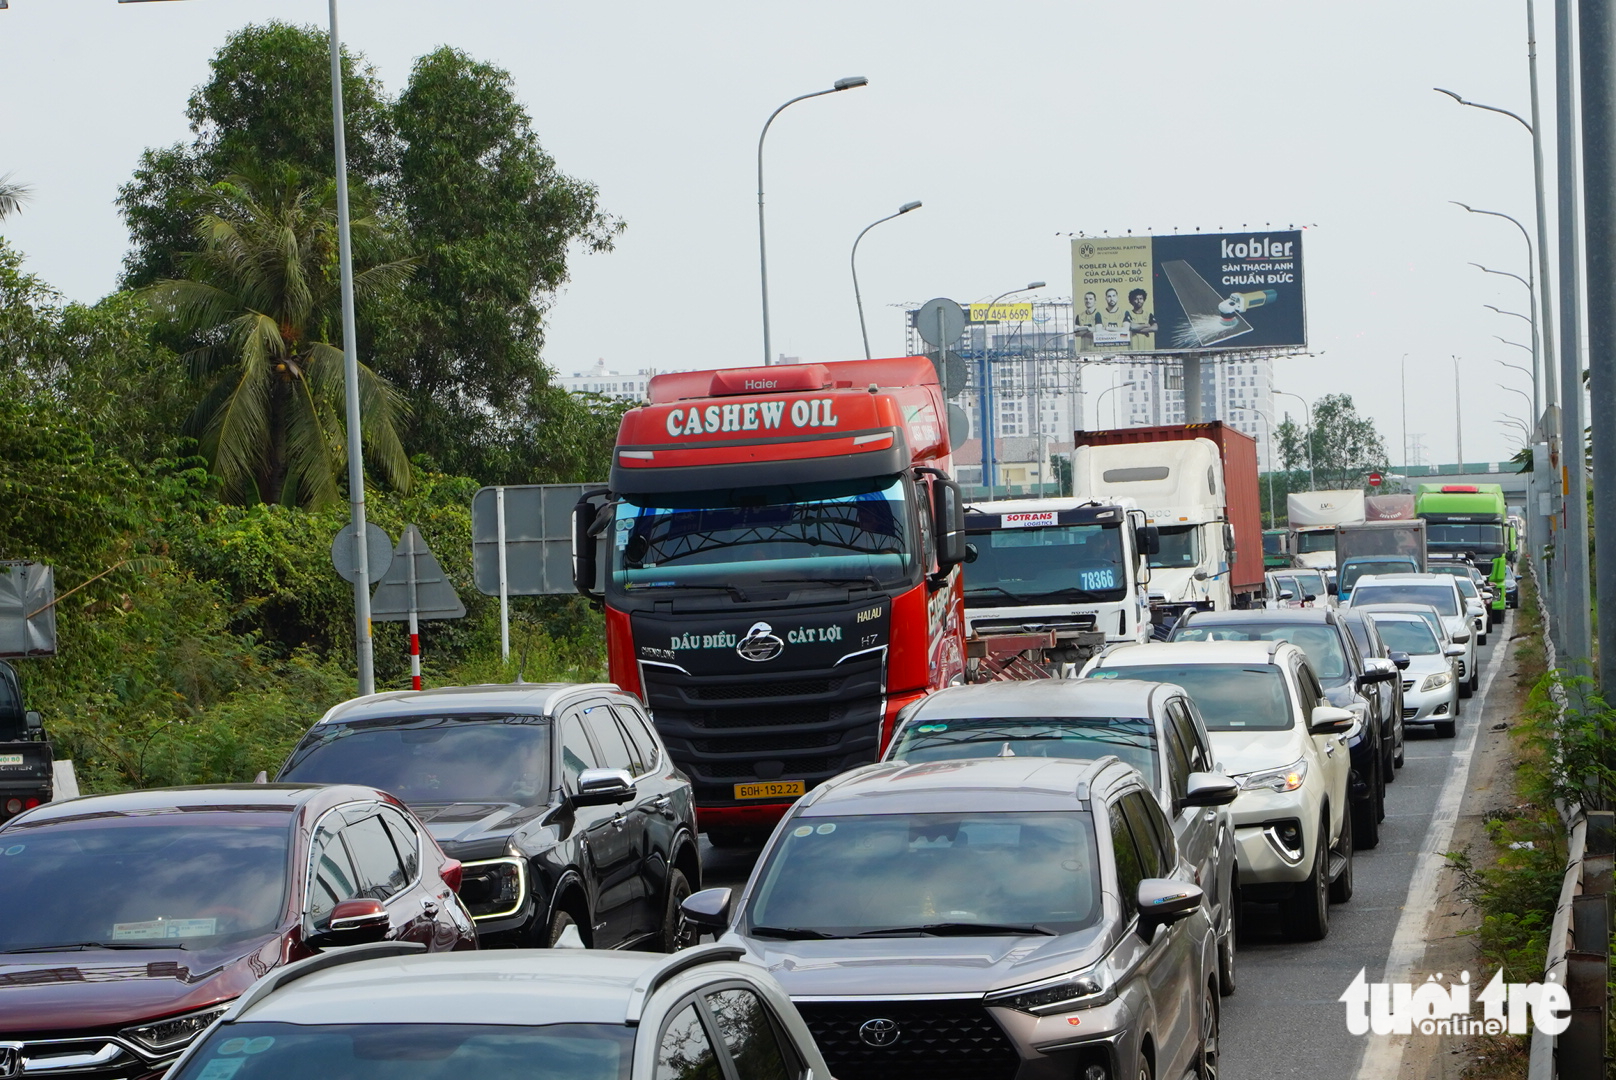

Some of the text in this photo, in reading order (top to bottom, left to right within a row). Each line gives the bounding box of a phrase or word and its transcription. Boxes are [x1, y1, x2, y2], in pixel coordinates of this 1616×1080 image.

[1221, 237, 1293, 258] kobler
[1222, 262, 1294, 273] SÀN THẠCH ANH
[1222, 271, 1294, 285] CHUẨN ĐỨC
[991, 309, 1007, 320] 464
[1009, 308, 1029, 320] 6699
[745, 379, 778, 390] Haier
[666, 399, 838, 437] CASHEW OIL
[1006, 512, 1053, 522] SOTRANS
[1081, 569, 1114, 591] 78366
[670, 625, 843, 651] DẦU ĐIỀU CÁT LỢI
[861, 634, 878, 647] H7
[740, 784, 799, 797] 60H-192.22
